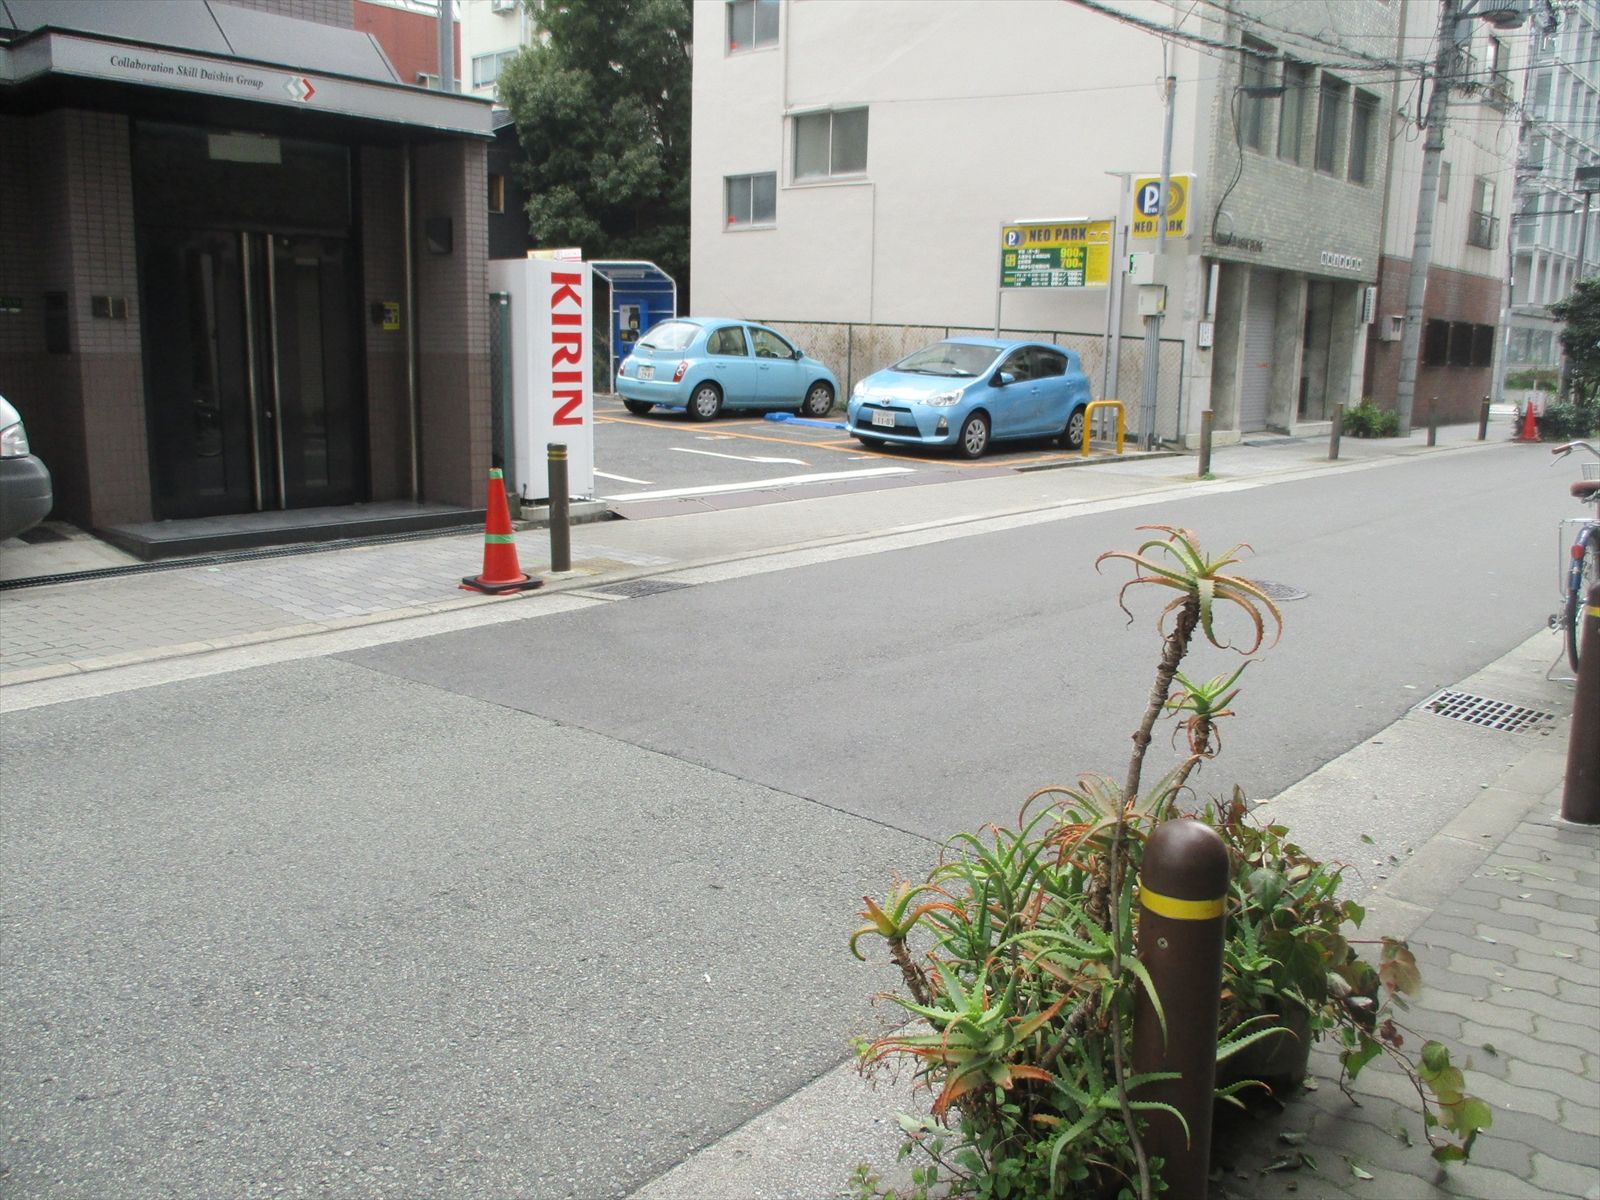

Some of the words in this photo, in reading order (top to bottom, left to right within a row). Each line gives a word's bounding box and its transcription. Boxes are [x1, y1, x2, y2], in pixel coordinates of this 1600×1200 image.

[110, 55, 174, 75] Collaboration
[176, 65, 198, 79] Skill
[200, 69, 234, 84] Daishin
[236, 74, 264, 90] Group
[1029, 228, 1051, 242] NEO
[1055, 227, 1086, 241] PARK
[1134, 221, 1153, 233] NEO
[1156, 219, 1183, 232] RK
[551, 271, 583, 427] KIRIN
